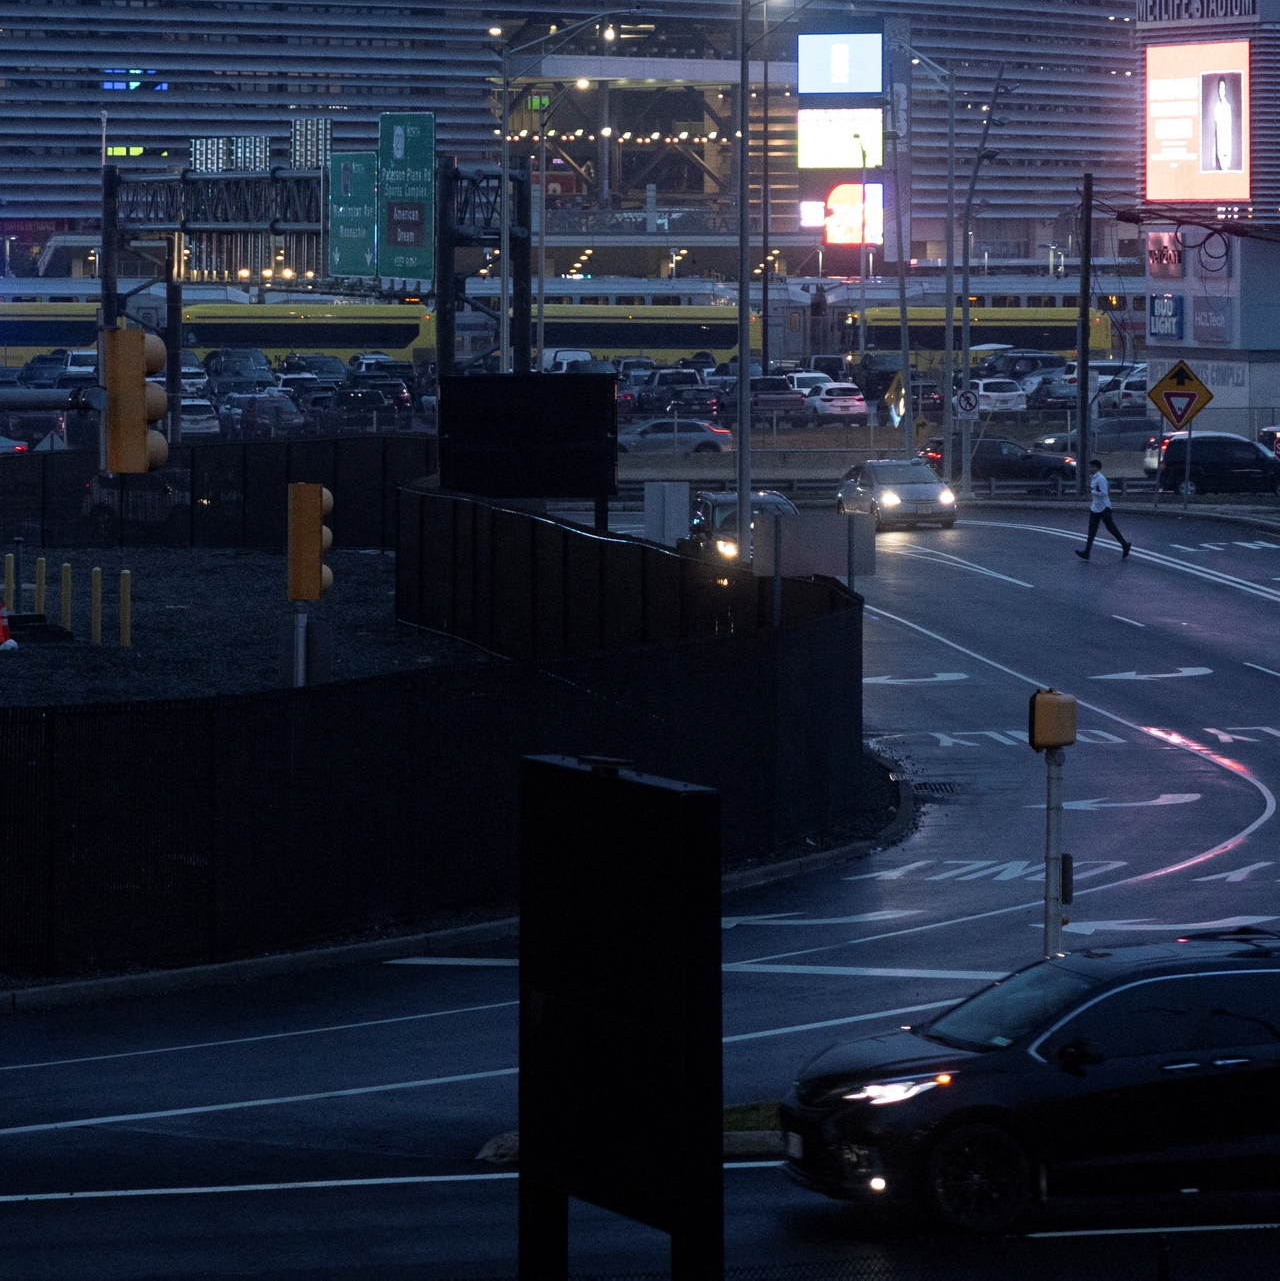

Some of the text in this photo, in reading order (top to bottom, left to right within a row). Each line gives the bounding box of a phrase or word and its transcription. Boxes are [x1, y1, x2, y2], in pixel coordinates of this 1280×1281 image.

[407, 167, 422, 182] Plank
[424, 167, 431, 182] Rd
[393, 207, 419, 221] American
[396, 228, 415, 243] Dream
[1154, 298, 1175, 317] BUD
[1151, 317, 1178, 336] LIGHT
